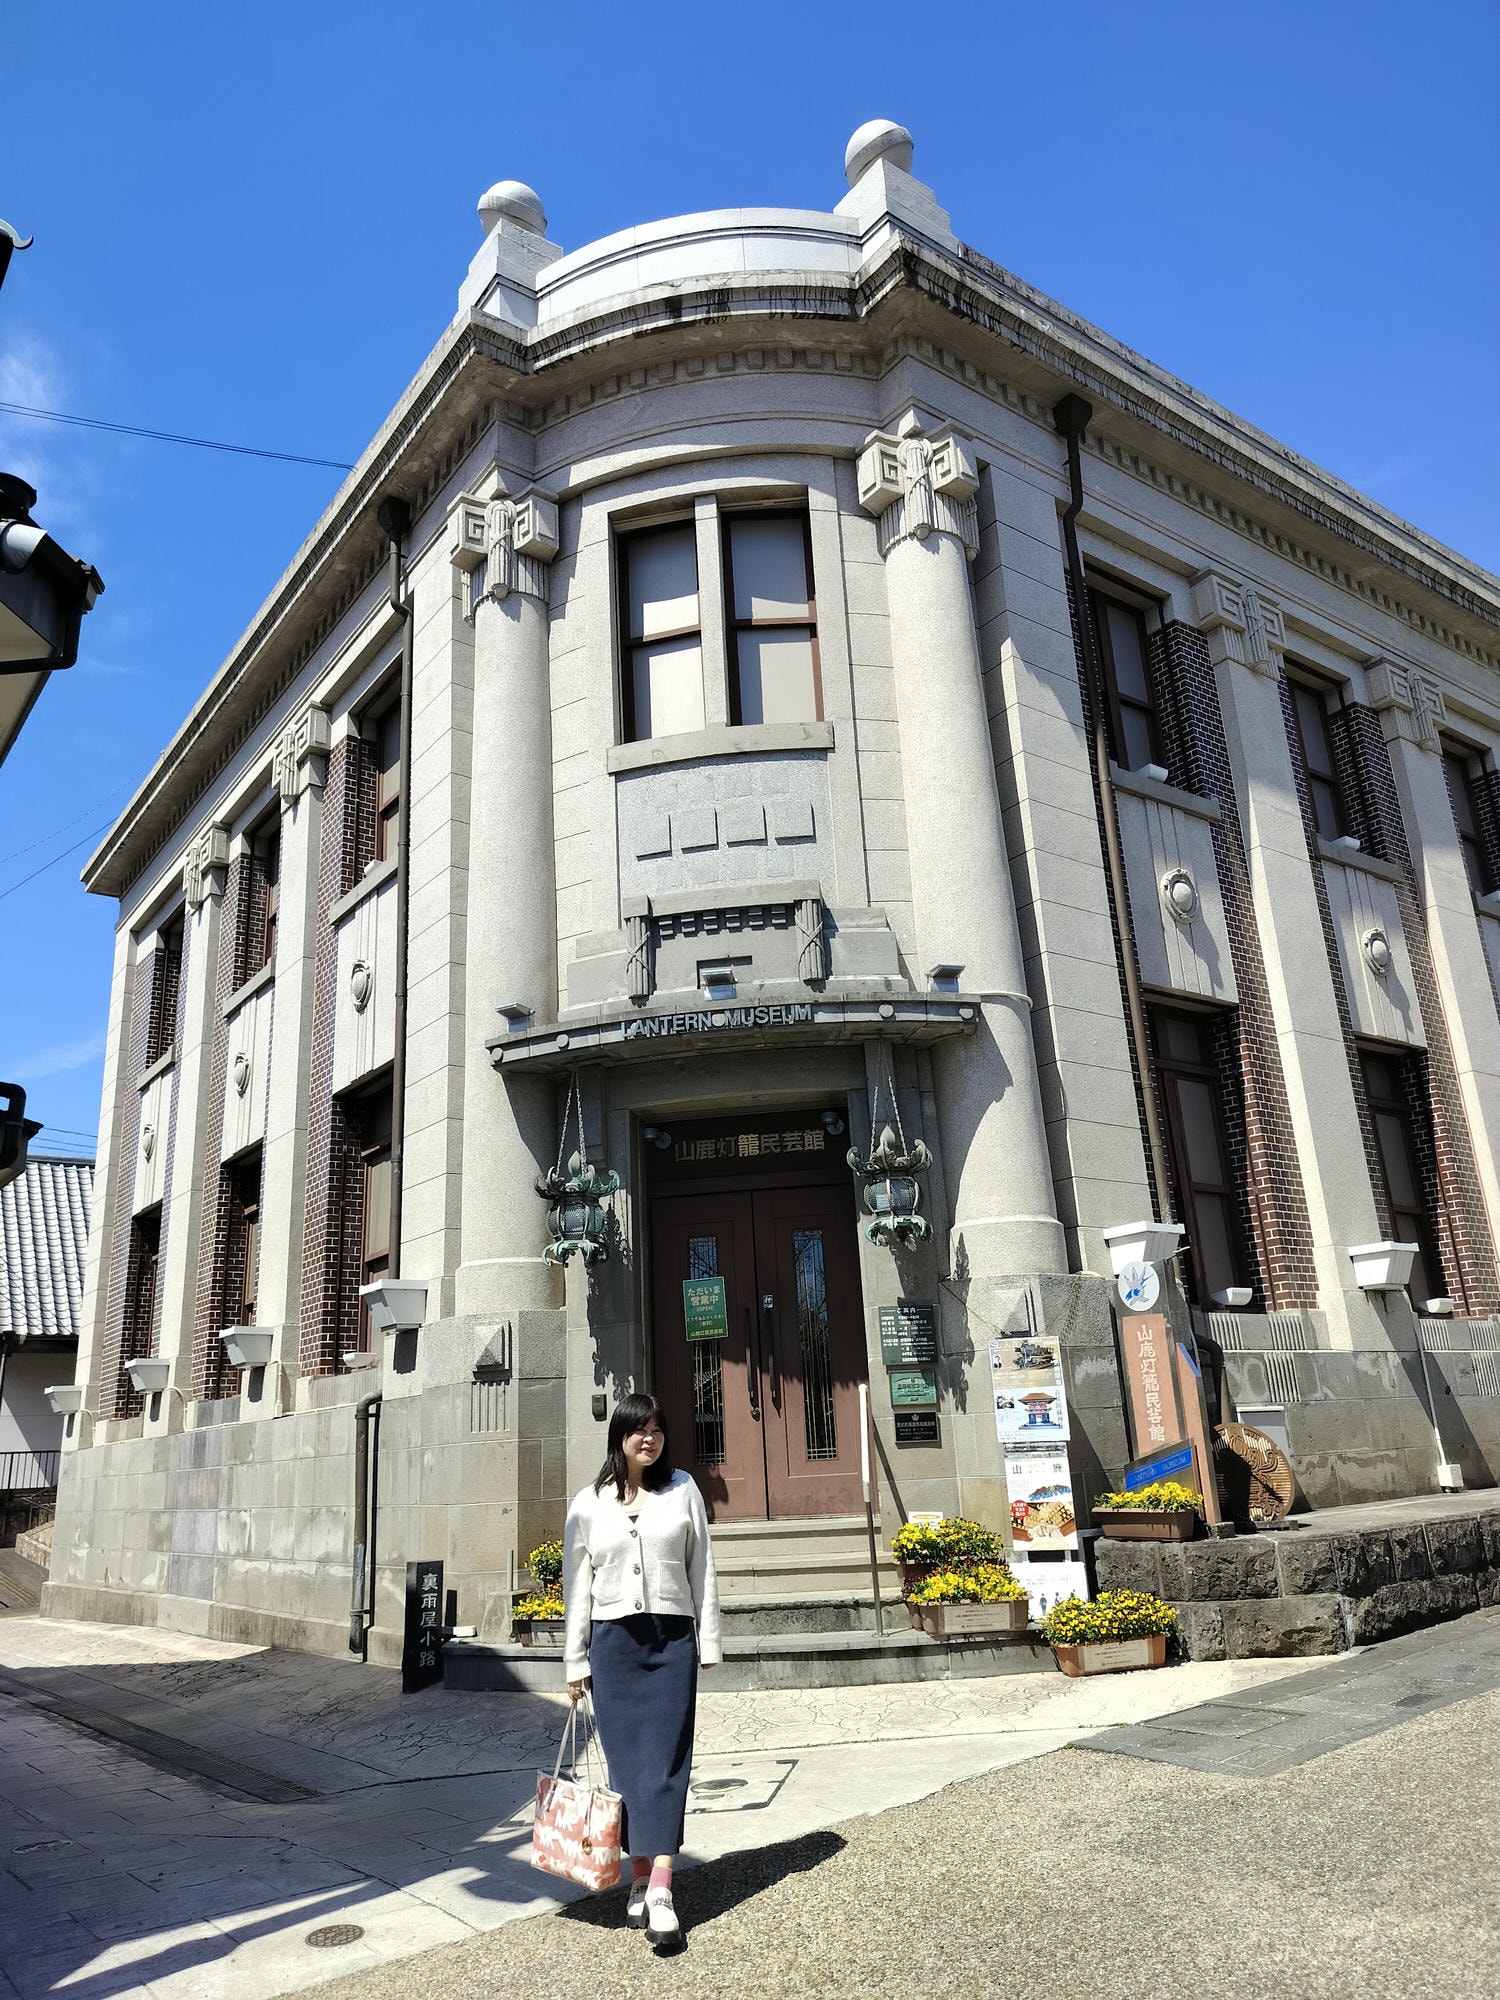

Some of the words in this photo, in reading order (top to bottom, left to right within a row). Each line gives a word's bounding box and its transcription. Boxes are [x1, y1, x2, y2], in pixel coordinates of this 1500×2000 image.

[621, 1011, 712, 1038] LANTERN
[724, 1004, 812, 1027] MUSEUM
[674, 1130, 825, 1162] 山鹿灯籠民芸館
[688, 1285, 721, 1297] ただいま
[691, 1294, 719, 1306] 営業中
[1137, 1323, 1165, 1442] 山鹿灯籠民芸館
